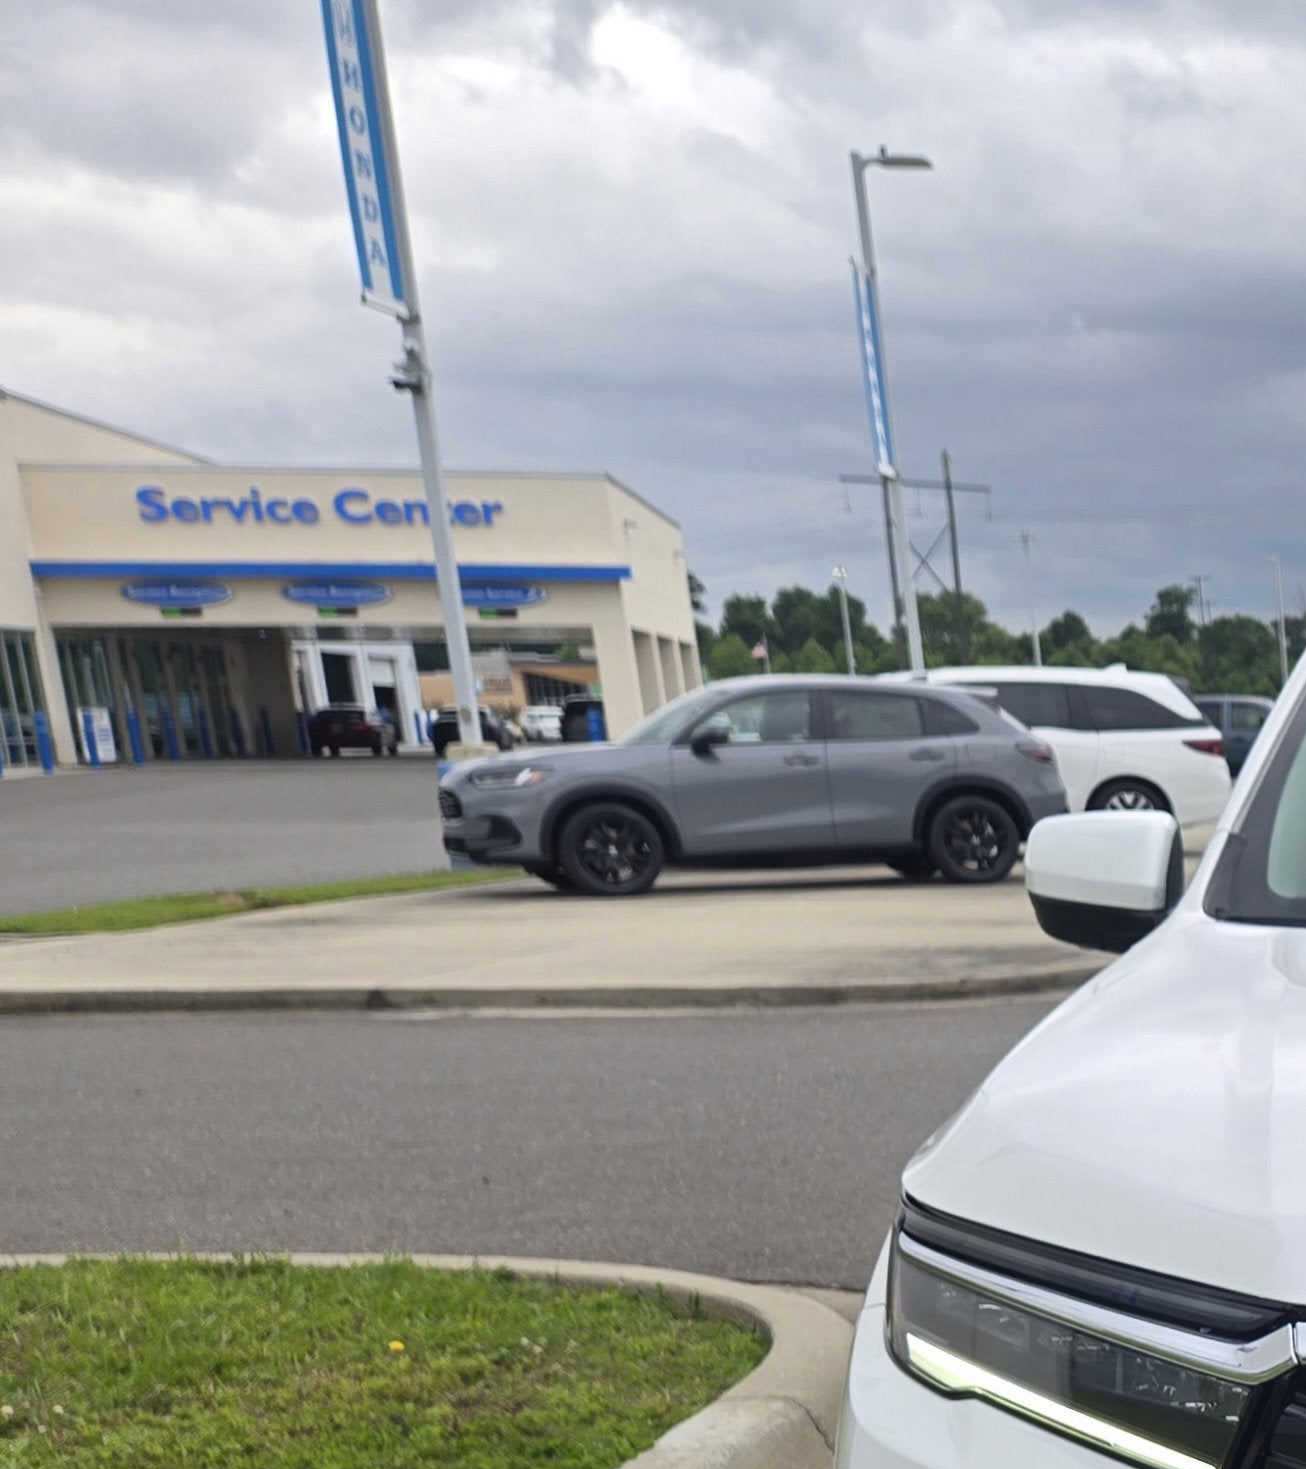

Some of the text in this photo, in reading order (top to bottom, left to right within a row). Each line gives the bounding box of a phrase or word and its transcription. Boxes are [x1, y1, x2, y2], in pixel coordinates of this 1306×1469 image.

[340, 59, 386, 268] HONDA
[135, 486, 503, 527] Service Cener
